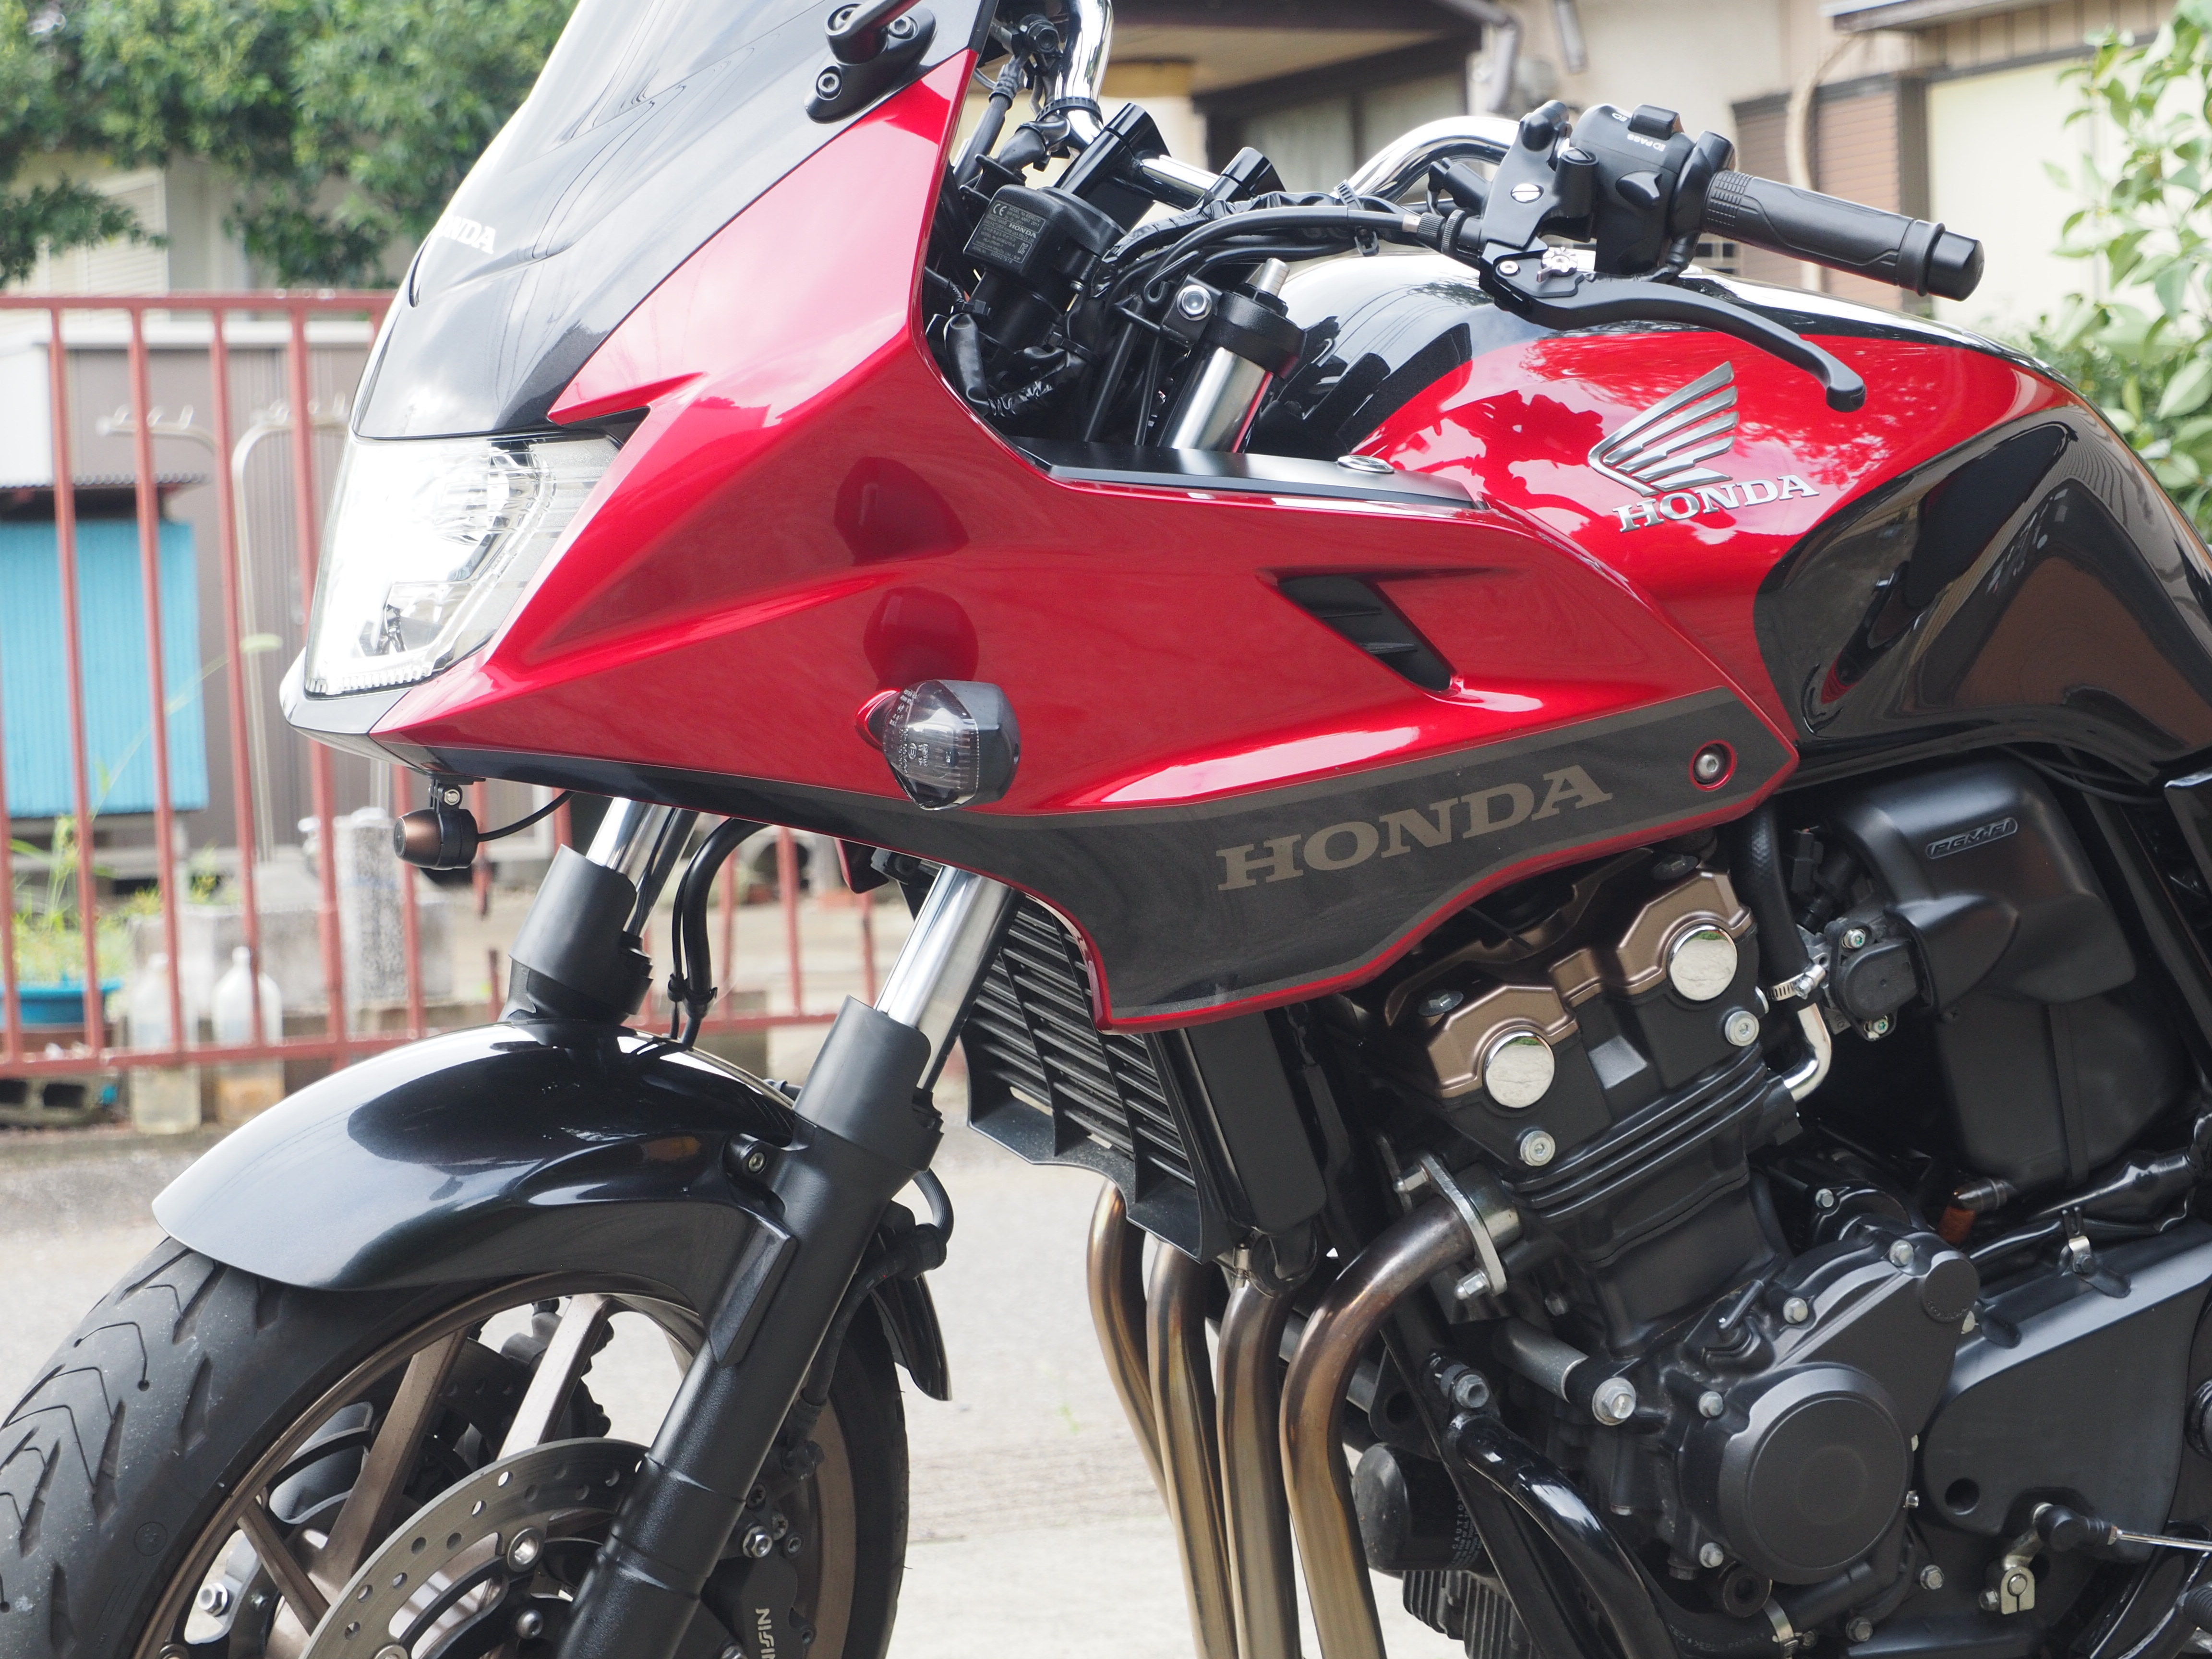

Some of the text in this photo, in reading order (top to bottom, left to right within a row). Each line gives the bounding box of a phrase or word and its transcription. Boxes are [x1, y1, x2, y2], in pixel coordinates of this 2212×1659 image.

[1627, 133, 1653, 147] PASS
[1008, 223, 1036, 238] HONDA
[1612, 474, 1819, 533] HONDA
[1216, 765, 1613, 891] HONDA
